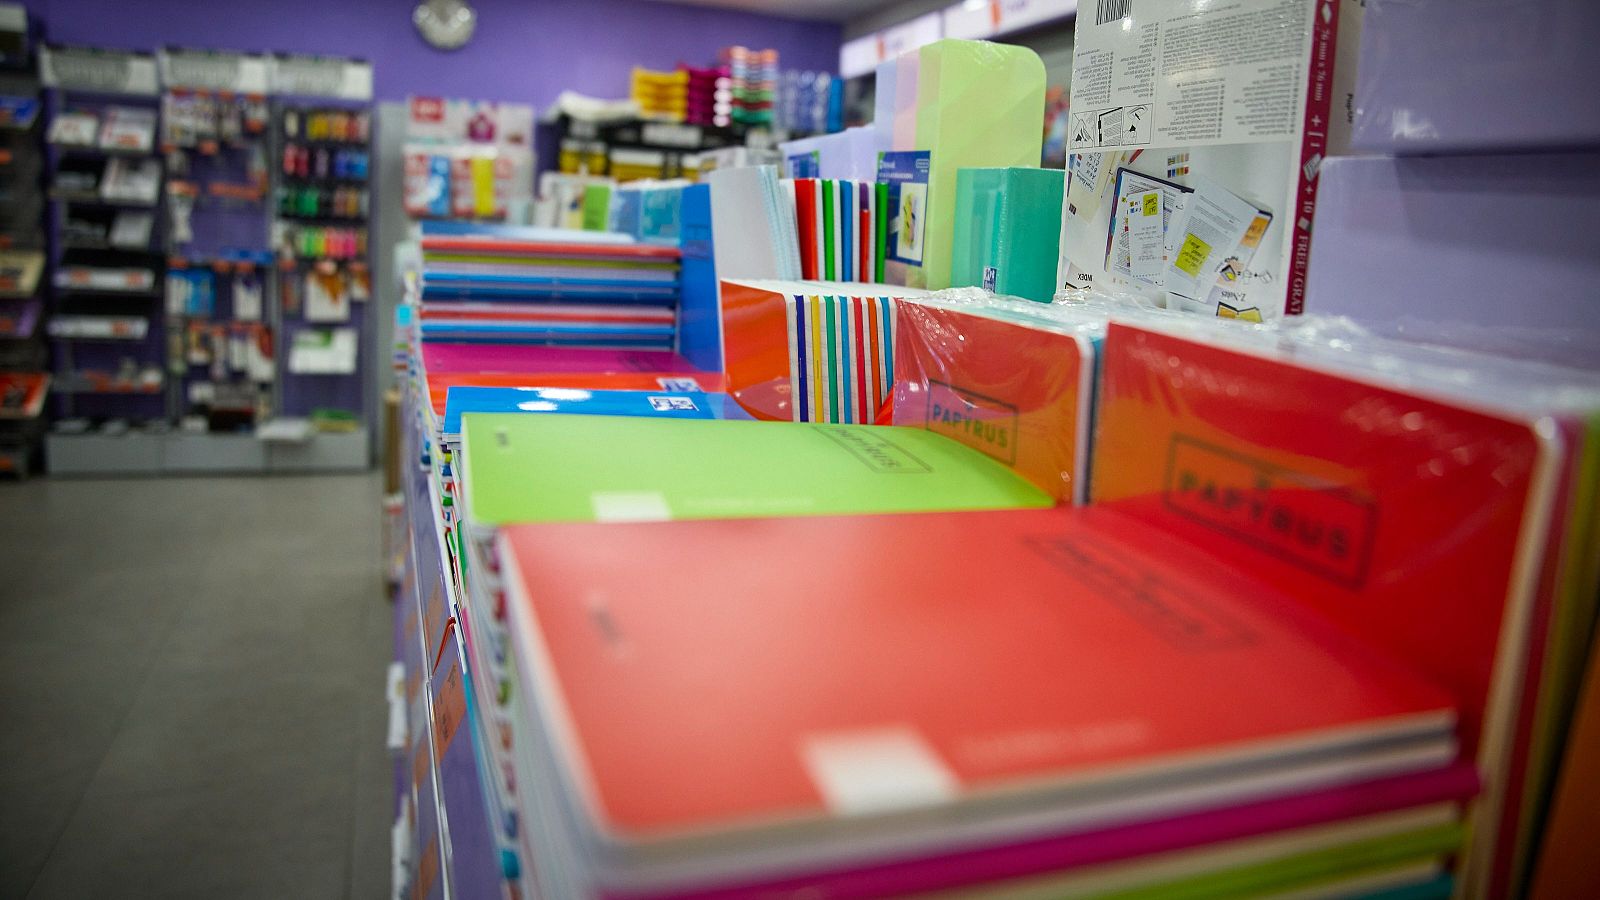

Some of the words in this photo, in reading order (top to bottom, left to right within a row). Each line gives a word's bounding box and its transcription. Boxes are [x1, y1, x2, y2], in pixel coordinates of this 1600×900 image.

[1319, 41, 1328, 60] mm
[1314, 82, 1324, 101] mm
[1295, 235, 1309, 269] FREE
[1077, 272, 1093, 282] INDEX
[1220, 290, 1246, 302] Z-Notes
[1290, 278, 1304, 313] GRAT
[933, 403, 1008, 449] PAPYRUS
[1180, 469, 1348, 559] PAPYRUS
